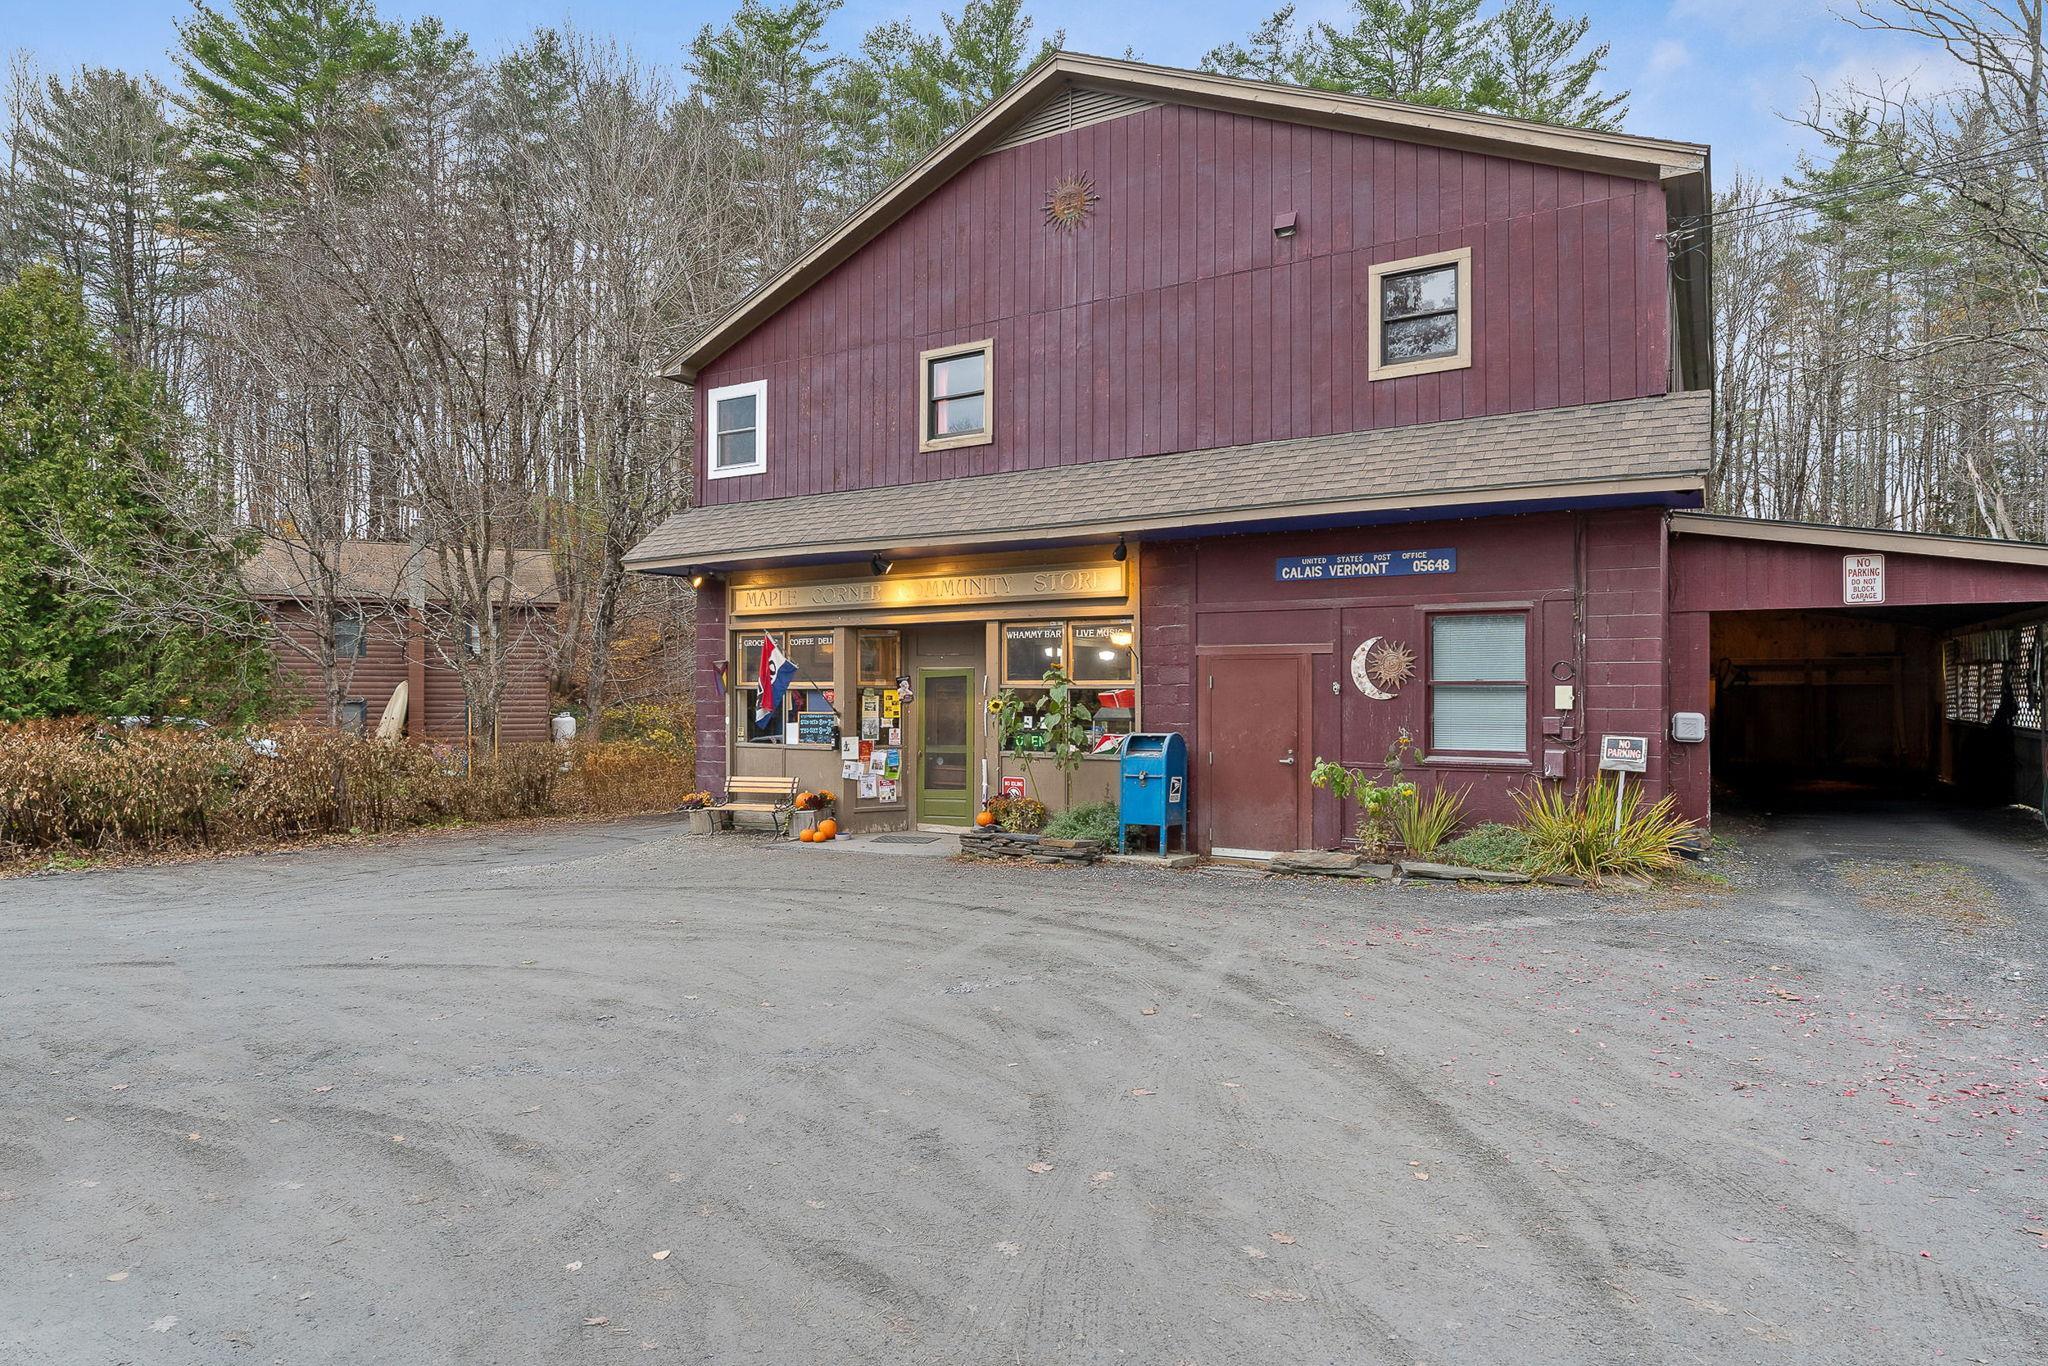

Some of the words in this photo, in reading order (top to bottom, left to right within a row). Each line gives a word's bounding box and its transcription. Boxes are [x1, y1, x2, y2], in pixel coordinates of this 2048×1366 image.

[1301, 557, 1327, 565] UNITED
[1336, 555, 1364, 563] STATES
[1373, 553, 1391, 561] POST
[1401, 551, 1427, 560] OFFICE
[1856, 558, 1871, 568] NO
[1281, 565, 1323, 579] CALAIS
[1328, 562, 1390, 577] VERMONT
[1412, 559, 1450, 572] 05648
[1848, 568, 1880, 577] PARKING
[745, 590, 798, 607] MAPLE
[811, 585, 881, 605] CORNER
[901, 576, 1013, 599] OMMUNITY
[1851, 592, 1878, 600] GARAGE
[1006, 630, 1042, 639] WHAMMY
[1044, 629, 1061, 638] BAR
[1076, 629, 1095, 638] LIVE
[789, 638, 814, 646] COFFEE
[818, 637, 833, 645] DELI
[1015, 735, 1046, 747] OEN
[1618, 740, 1631, 749] NO
[1607, 748, 1641, 759] PARKING
